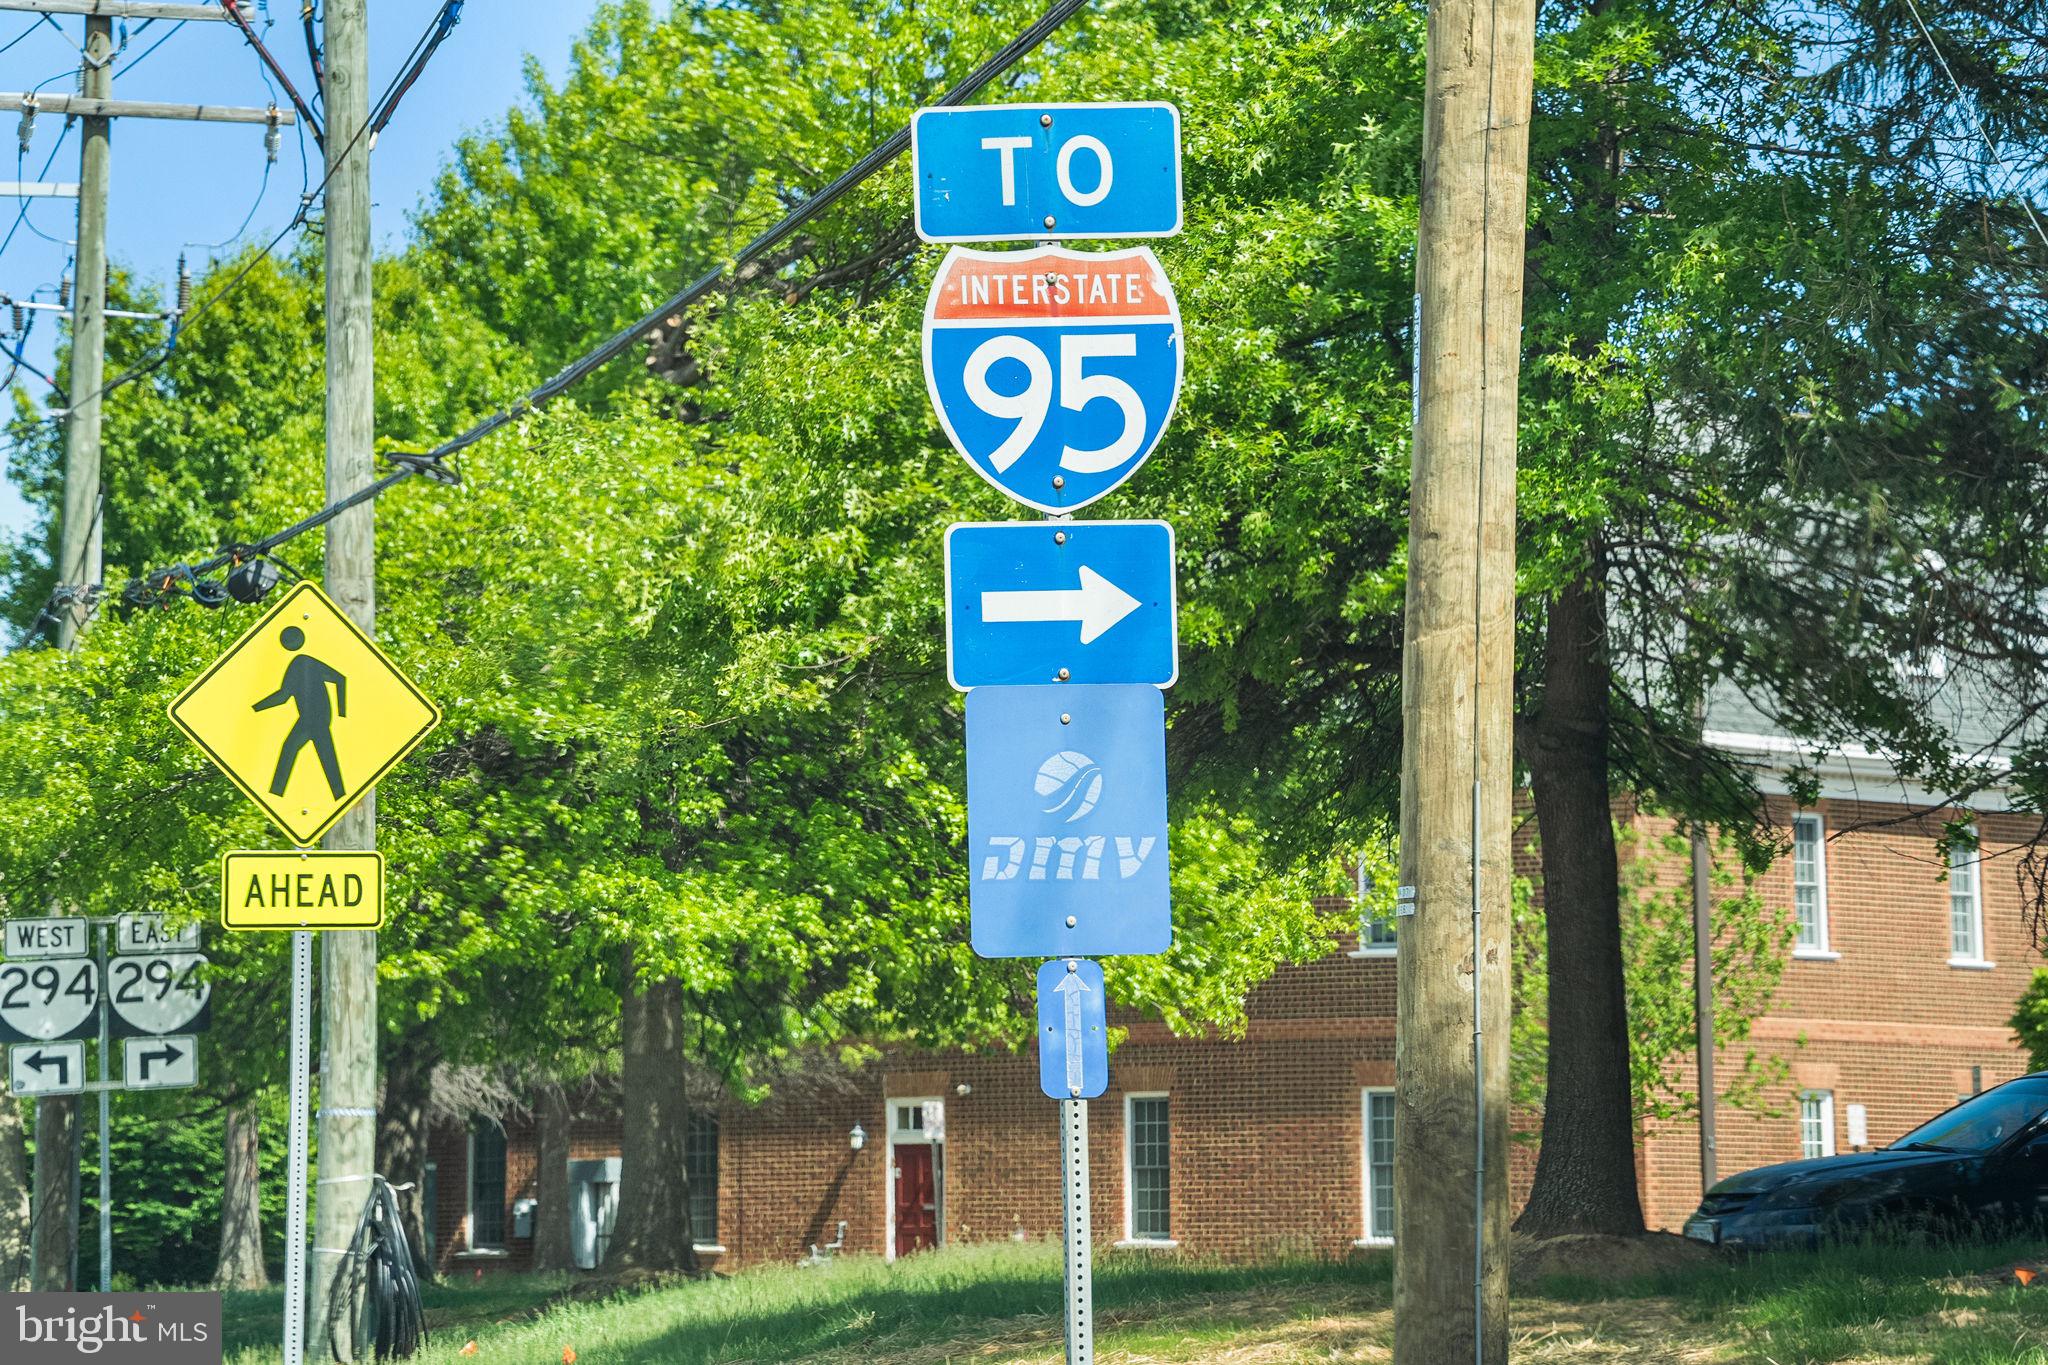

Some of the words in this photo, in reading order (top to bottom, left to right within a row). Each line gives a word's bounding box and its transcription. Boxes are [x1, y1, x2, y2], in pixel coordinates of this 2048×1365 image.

[981, 134, 1114, 207] TO
[960, 272, 1142, 305] INTERSTATE
[963, 333, 1147, 475] 95
[244, 873, 363, 908] AHEAD
[17, 925, 75, 948] WEST
[0, 964, 96, 1010] 294
[114, 959, 206, 1005] 294
